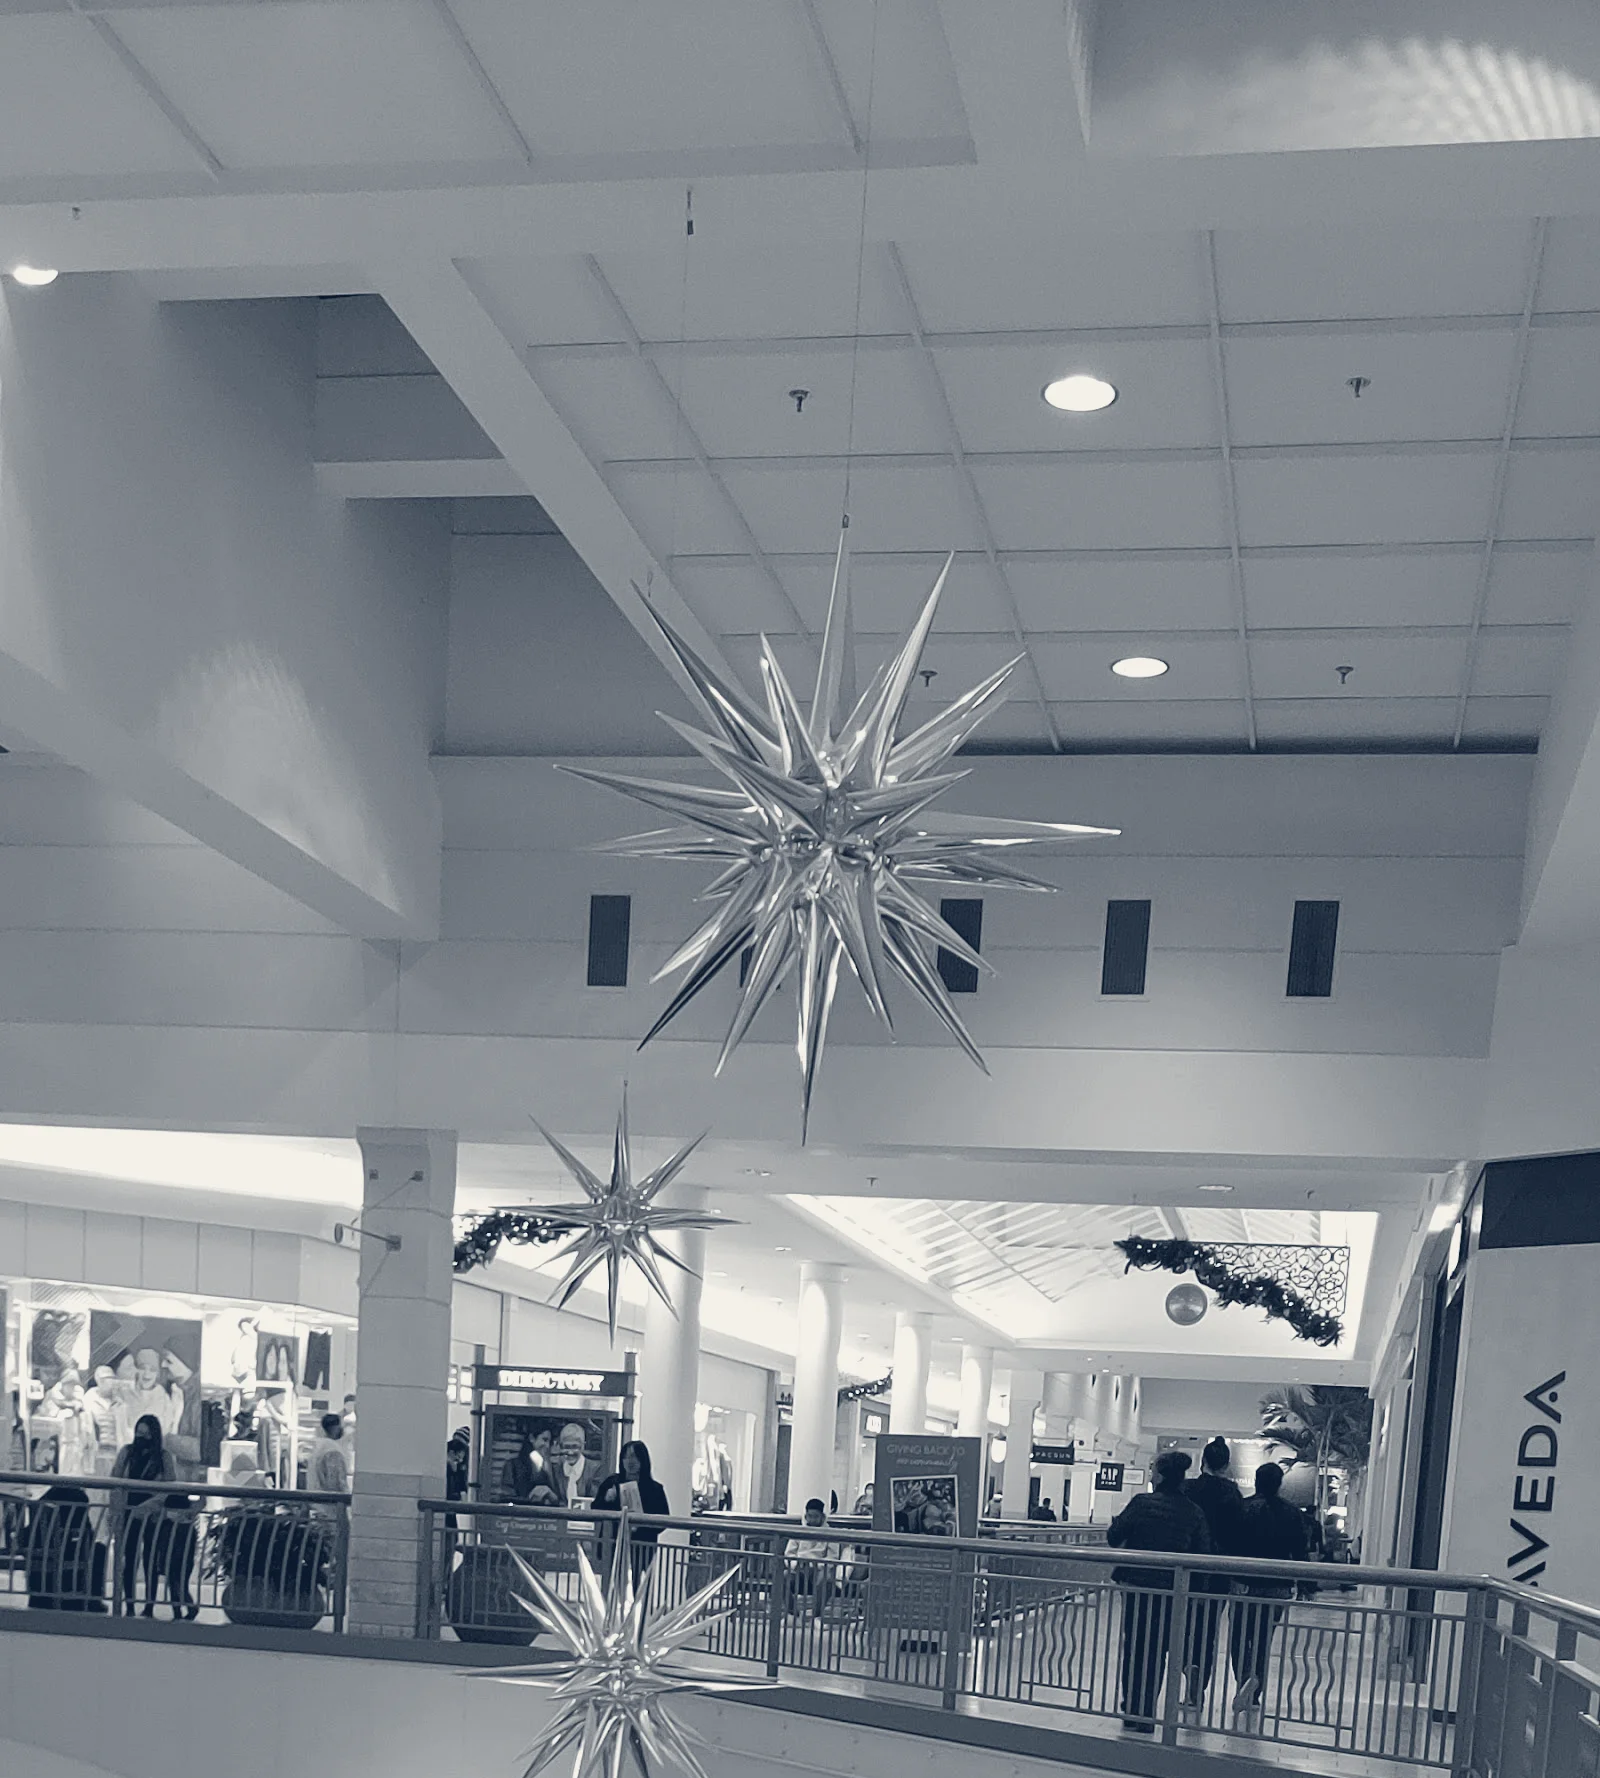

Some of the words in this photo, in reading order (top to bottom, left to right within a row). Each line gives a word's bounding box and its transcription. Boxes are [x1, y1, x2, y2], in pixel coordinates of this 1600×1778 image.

[499, 1370, 604, 1391] DIRECTORY
[886, 1444, 921, 1456] GIVING
[923, 1444, 949, 1456] BACK
[1035, 1451, 1071, 1459] PACSUN
[1101, 1467, 1119, 1481] GAP
